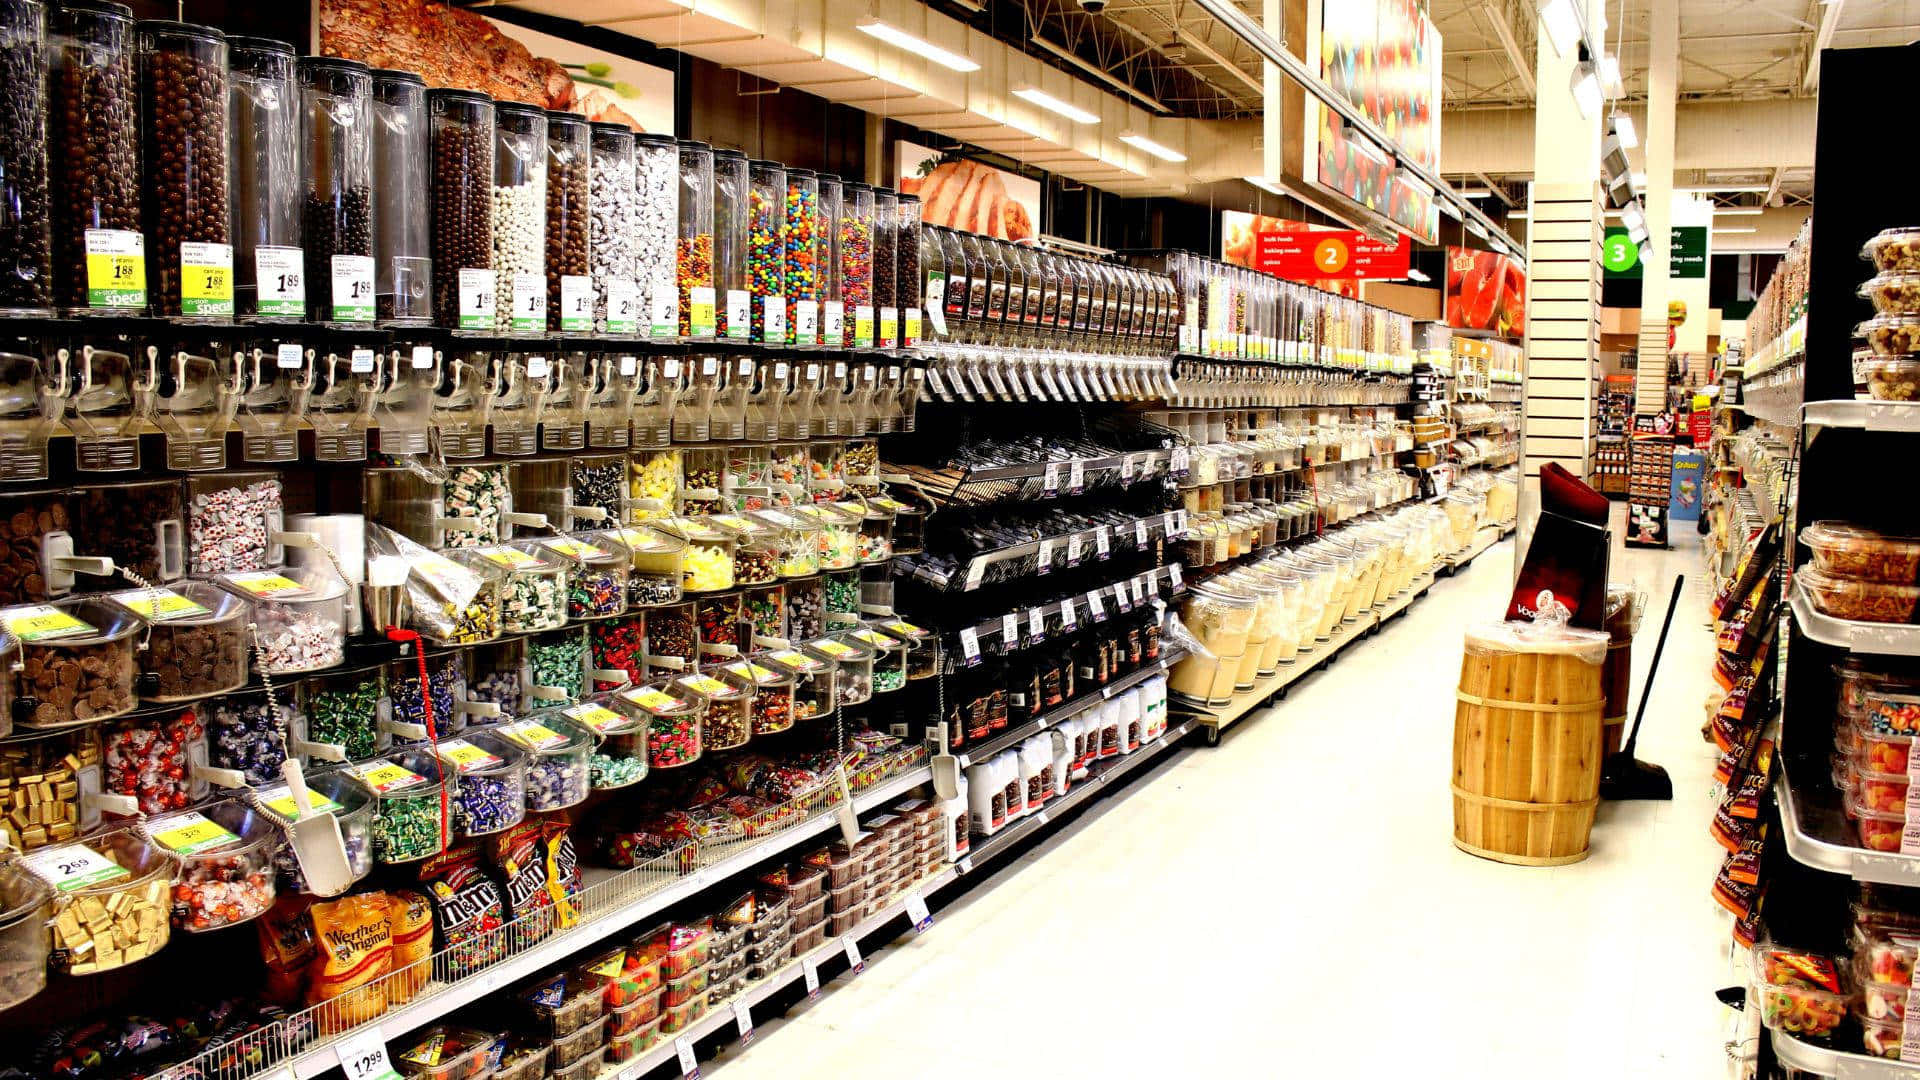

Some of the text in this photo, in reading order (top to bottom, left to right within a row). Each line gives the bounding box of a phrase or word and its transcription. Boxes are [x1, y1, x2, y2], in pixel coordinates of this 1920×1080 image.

[1324, 248, 1338, 265] 2
[1612, 244, 1626, 262] 3
[58, 858, 90, 875] 269
[325, 917, 392, 946] Werther's
[346, 926, 391, 952] Original
[354, 1051, 382, 1078] 1299
